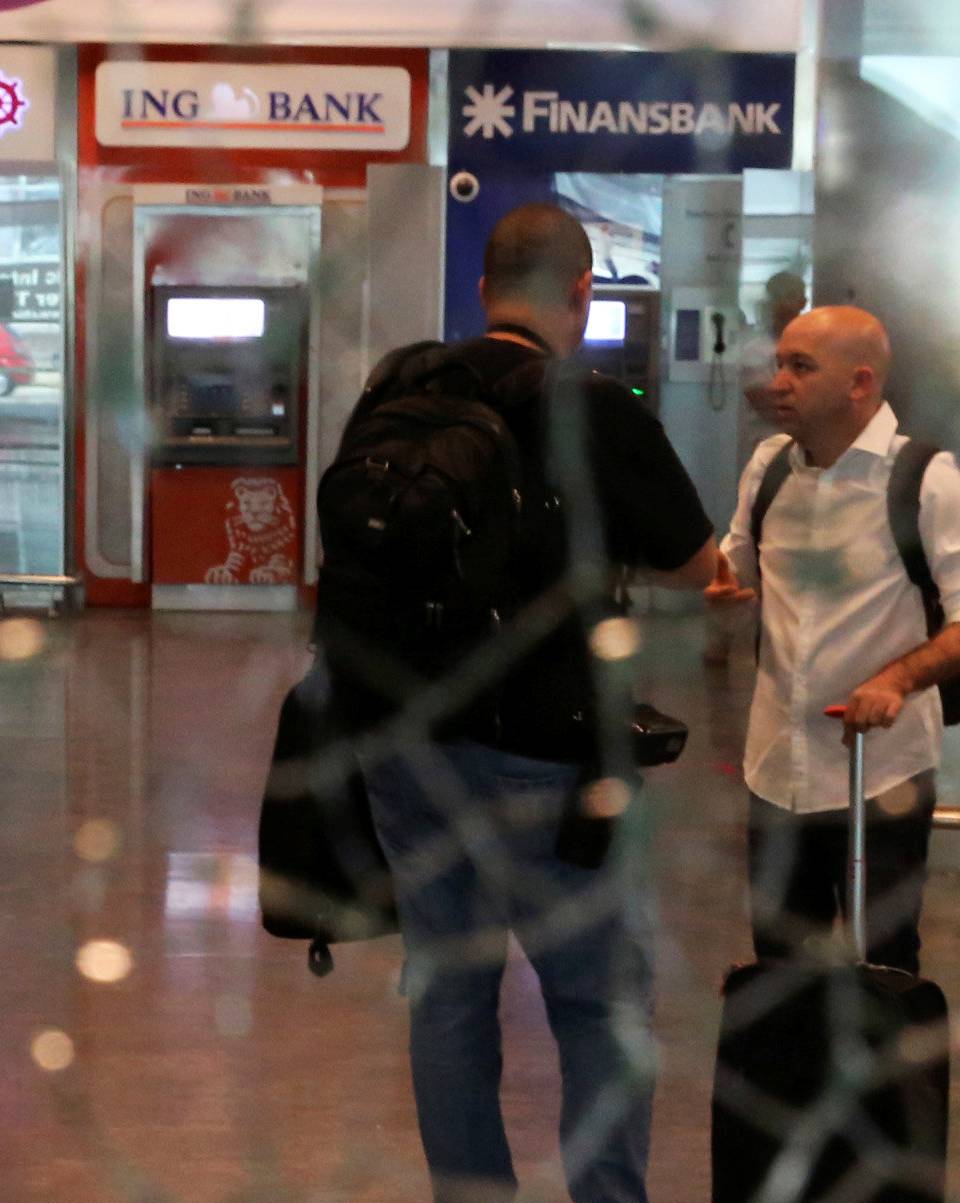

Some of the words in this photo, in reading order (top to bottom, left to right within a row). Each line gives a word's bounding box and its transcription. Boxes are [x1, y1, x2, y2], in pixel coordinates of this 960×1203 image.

[122, 89, 200, 120] ING
[267, 91, 384, 122] BANK
[522, 91, 781, 135] FINANSBANK
